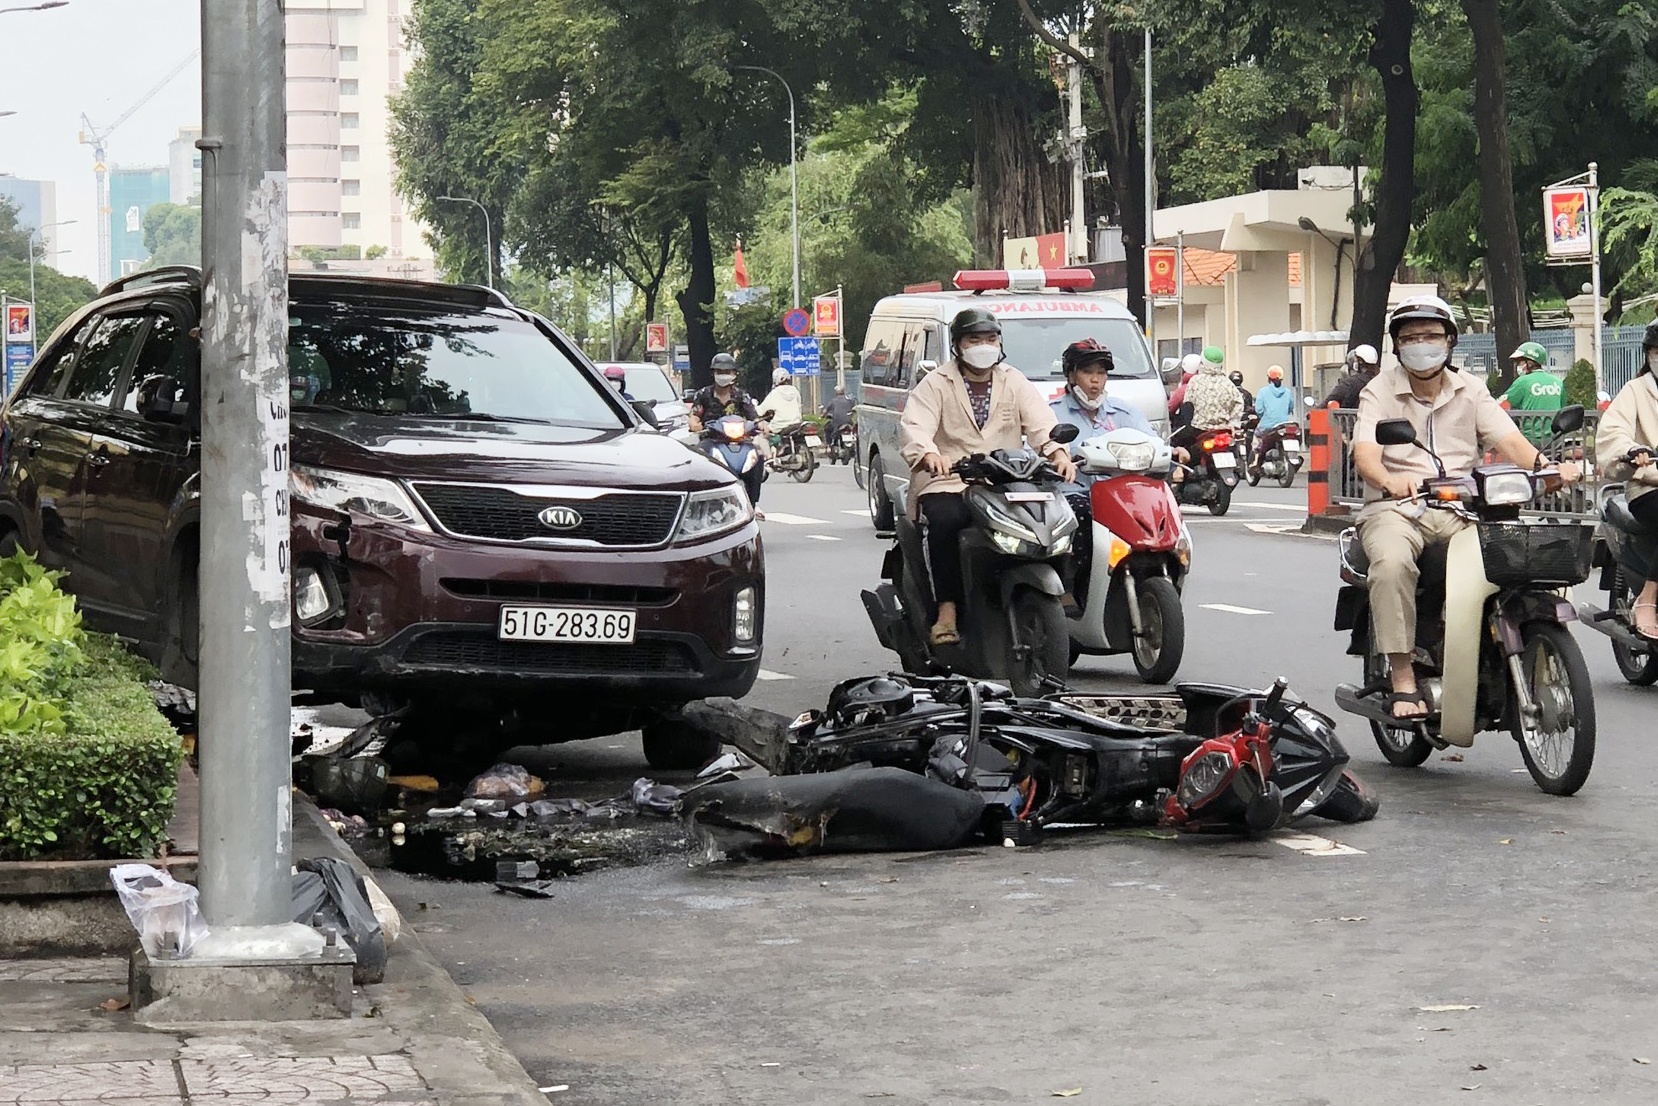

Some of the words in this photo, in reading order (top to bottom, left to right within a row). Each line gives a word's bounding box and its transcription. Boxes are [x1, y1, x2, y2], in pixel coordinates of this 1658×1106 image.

[1530, 381, 1562, 396] Grab
[546, 511, 576, 525] KIA
[503, 610, 631, 639] 51G-283.69
